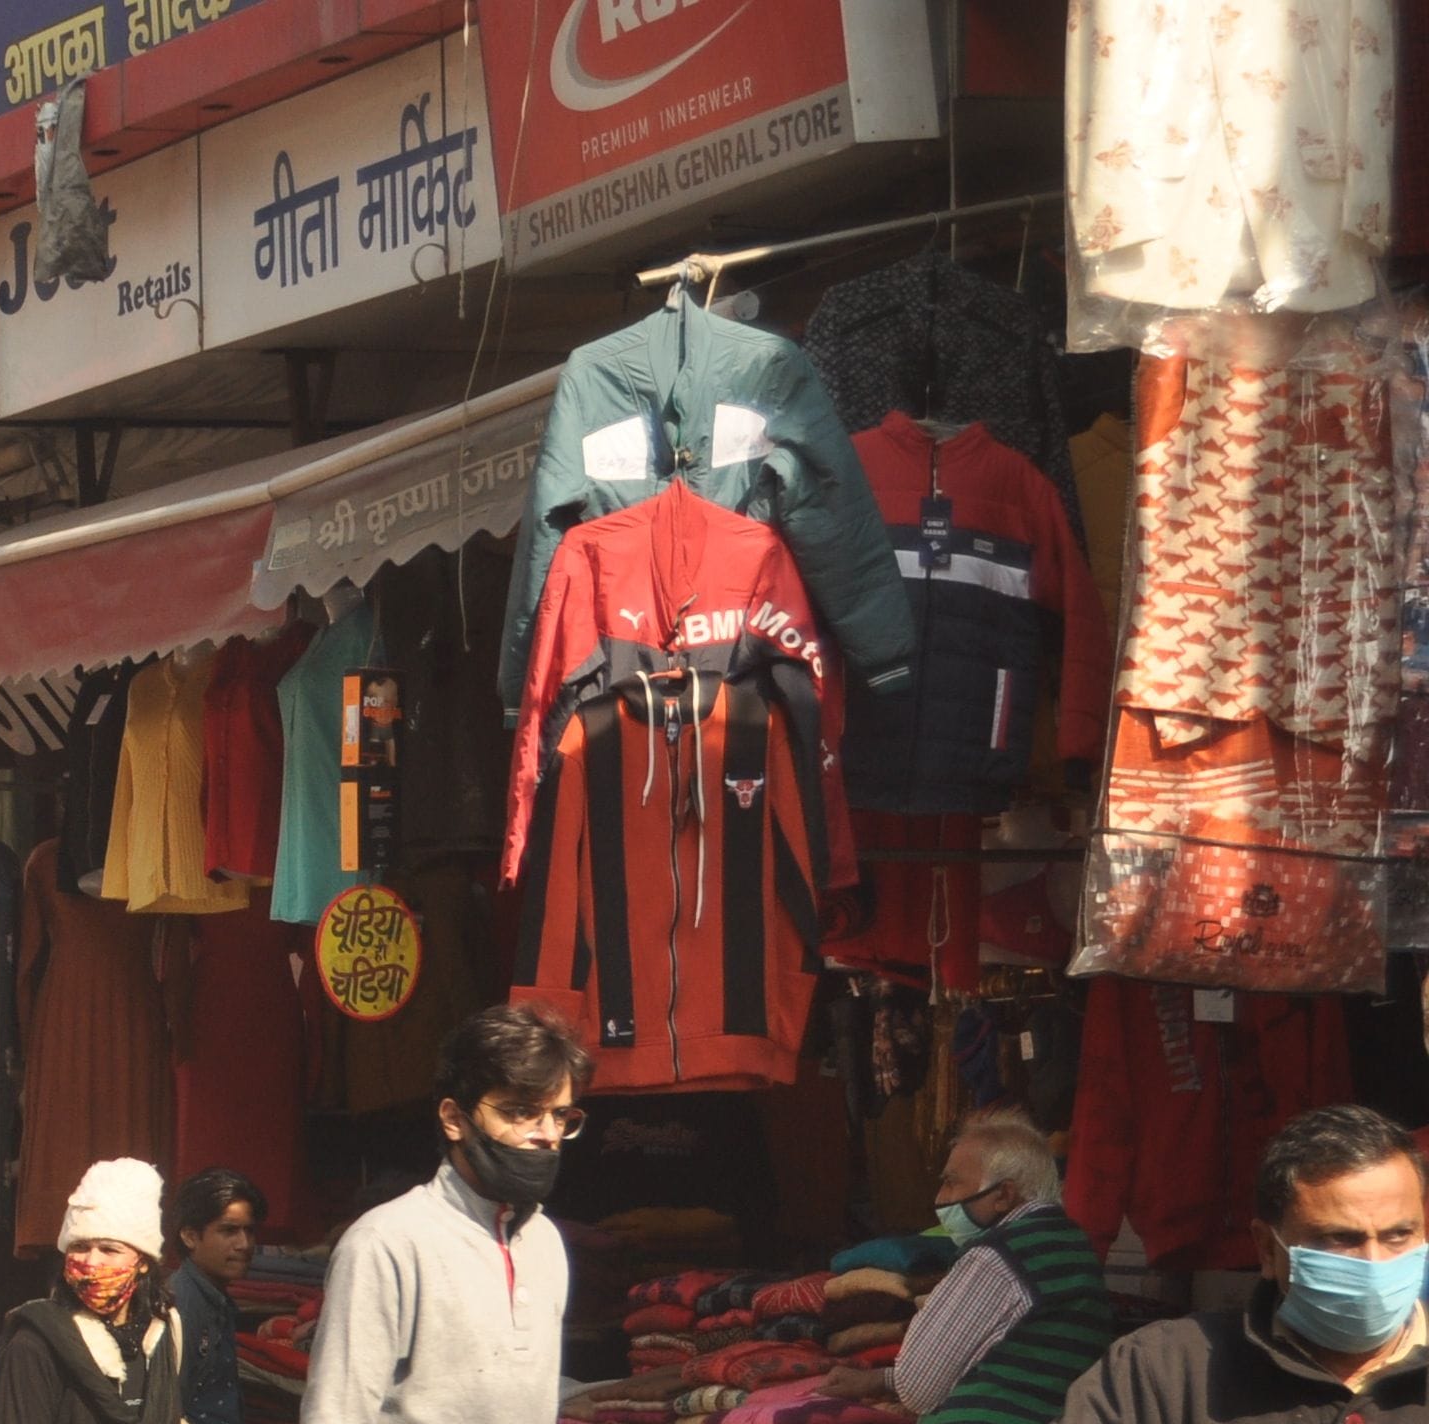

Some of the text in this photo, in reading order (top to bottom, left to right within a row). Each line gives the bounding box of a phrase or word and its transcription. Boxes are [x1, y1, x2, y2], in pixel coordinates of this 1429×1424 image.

[4, 5, 106, 105] आपका
[581, 75, 755, 163] PREMIUM INNERWEAR
[253, 93, 479, 290] गीता मार्किट
[528, 95, 842, 249] SHRI KRISHNA GENRAL STORE
[117, 260, 192, 317] Retails
[316, 472, 450, 550] श्री कृष्णा
